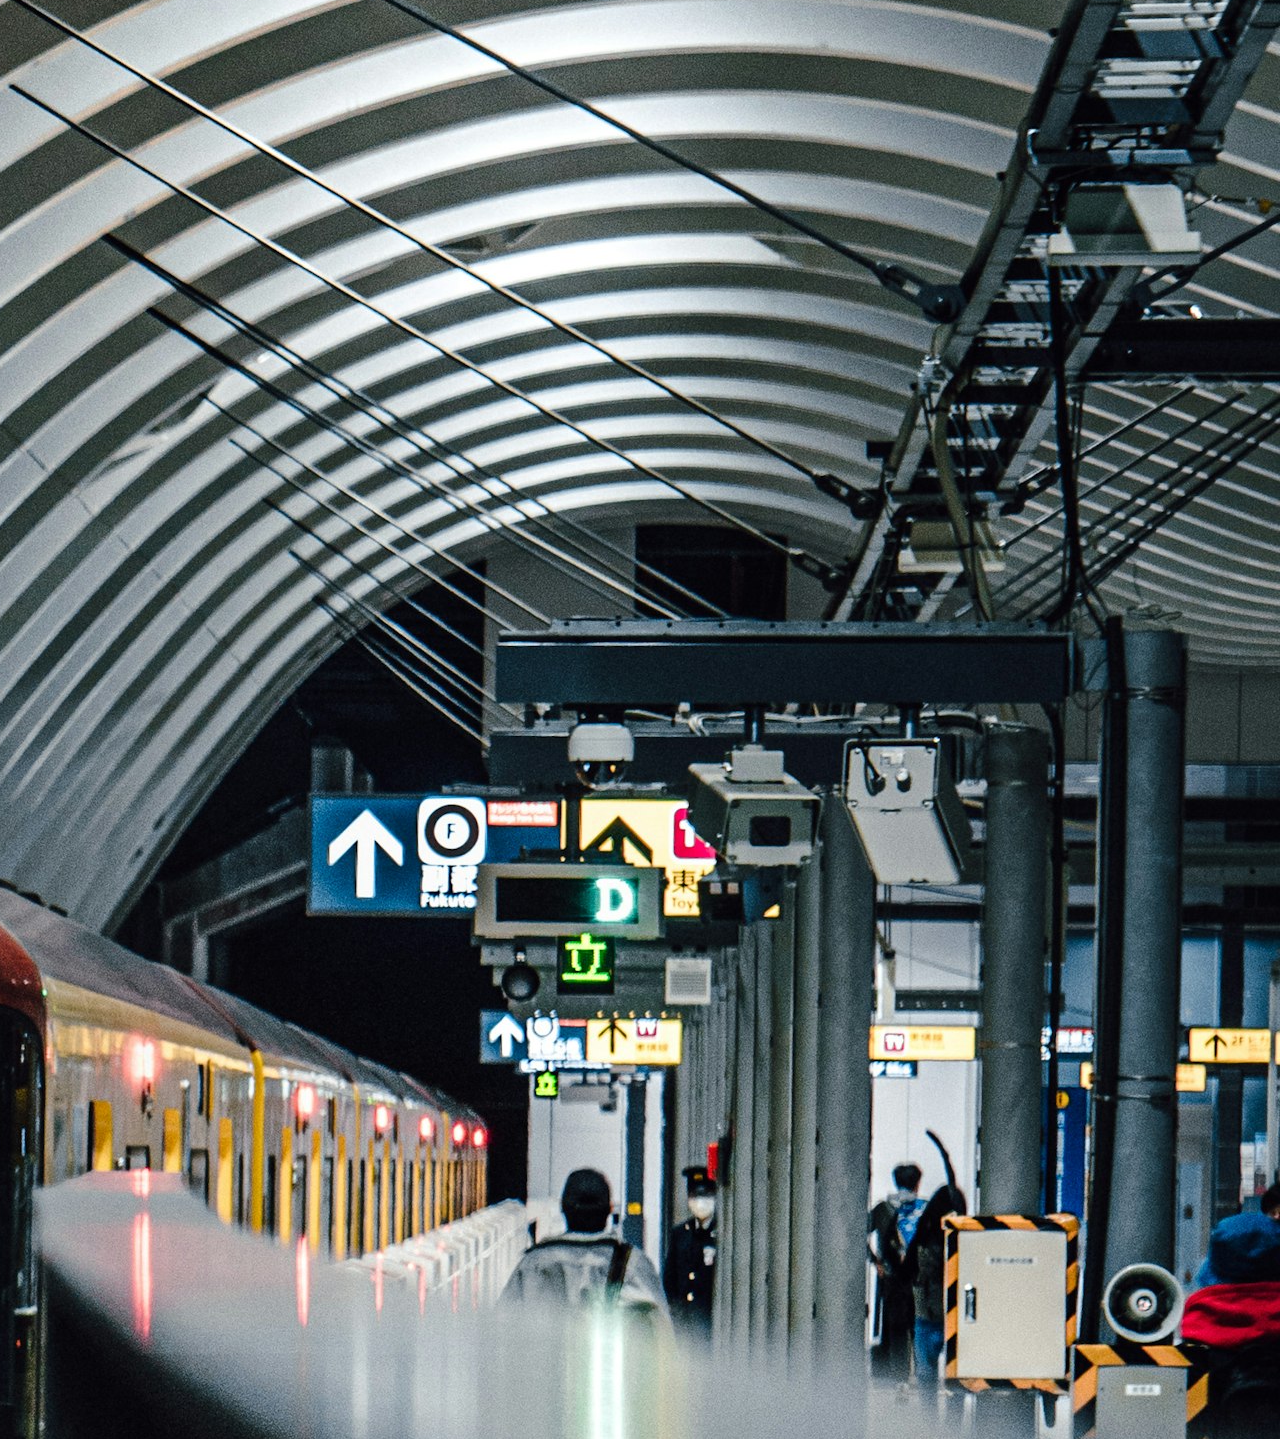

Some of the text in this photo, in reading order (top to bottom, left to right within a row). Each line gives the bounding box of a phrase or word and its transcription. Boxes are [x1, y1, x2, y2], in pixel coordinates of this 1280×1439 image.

[447, 823, 456, 839] F
[672, 870, 705, 894] 東
[596, 878, 634, 922] D
[672, 897, 699, 910] Toy
